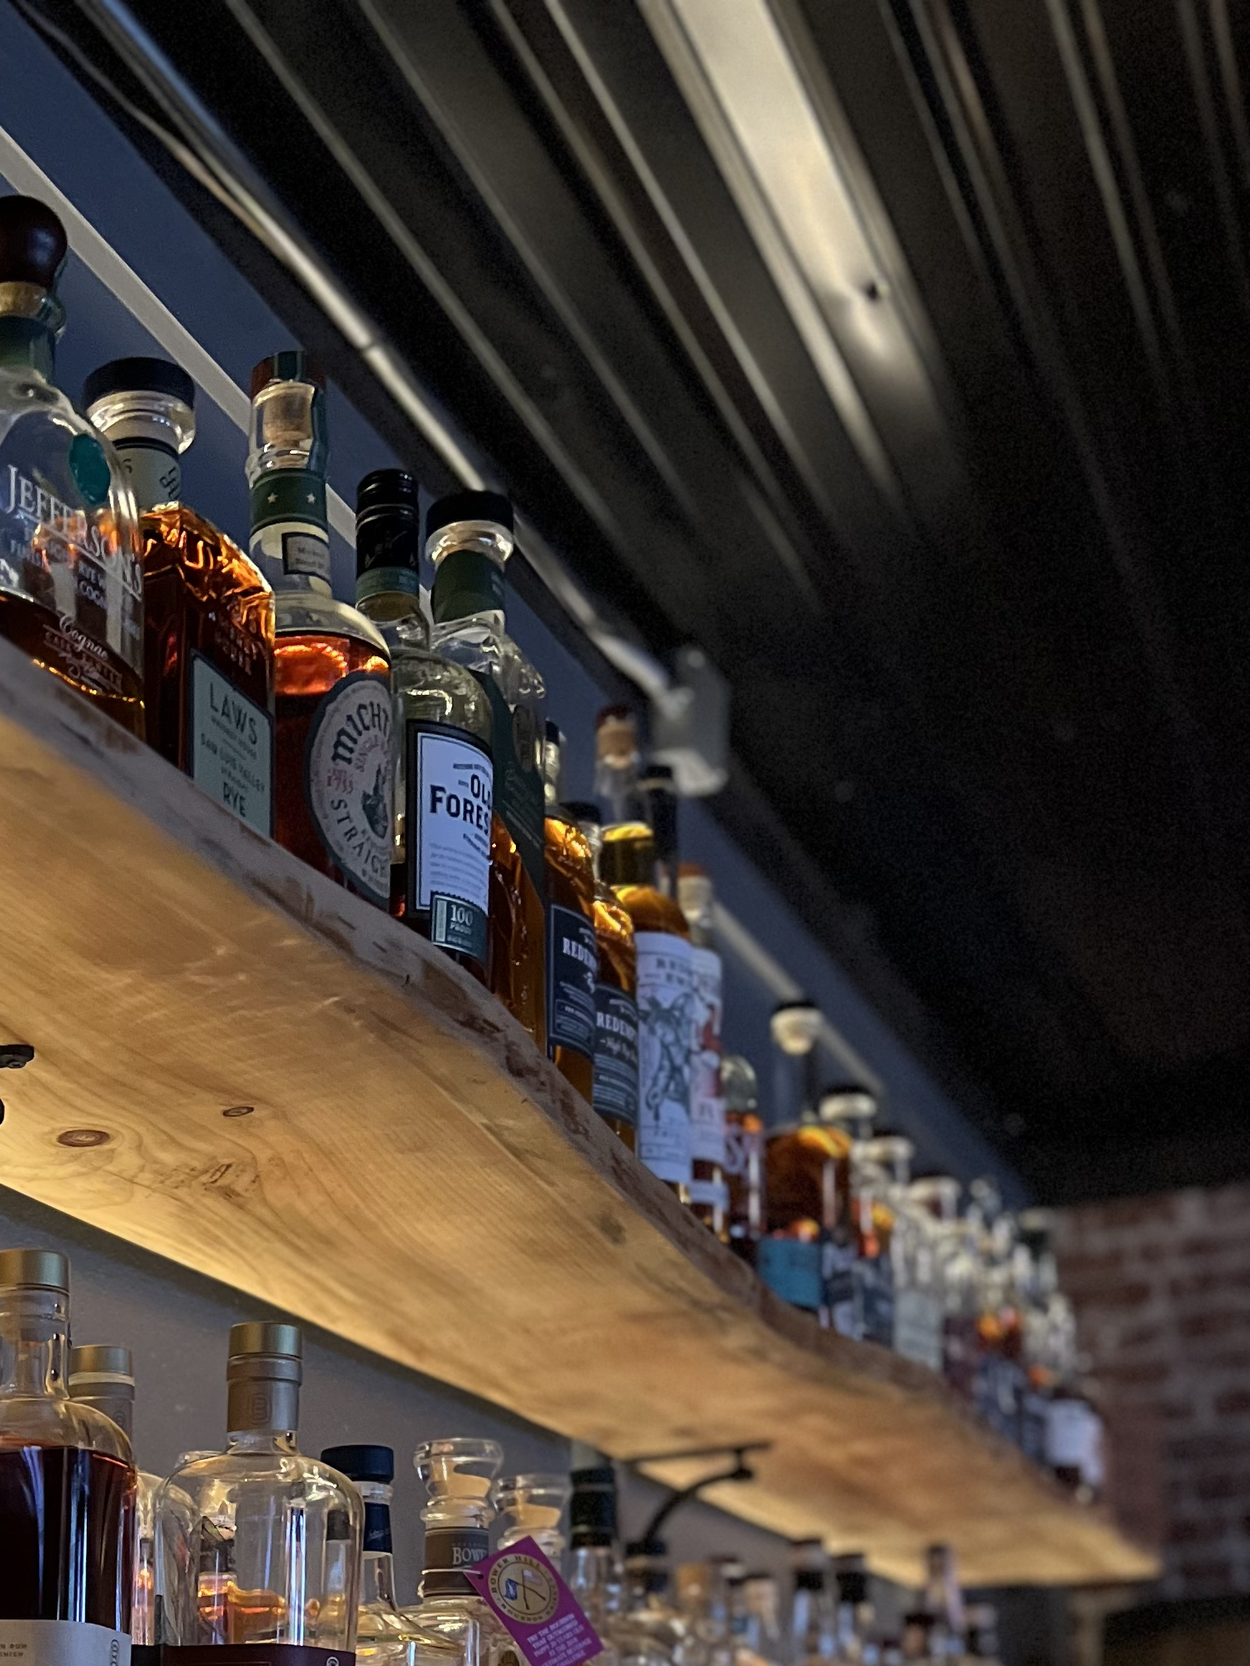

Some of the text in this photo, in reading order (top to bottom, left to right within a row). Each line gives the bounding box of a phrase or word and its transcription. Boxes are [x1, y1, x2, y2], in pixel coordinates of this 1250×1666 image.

[209, 682, 257, 745] LAWS
[331, 700, 389, 766] MICHT
[223, 781, 247, 818] RYE
[430, 784, 491, 834] FORES
[450, 904, 473, 926] 100
[453, 1547, 488, 1565] BOWE
